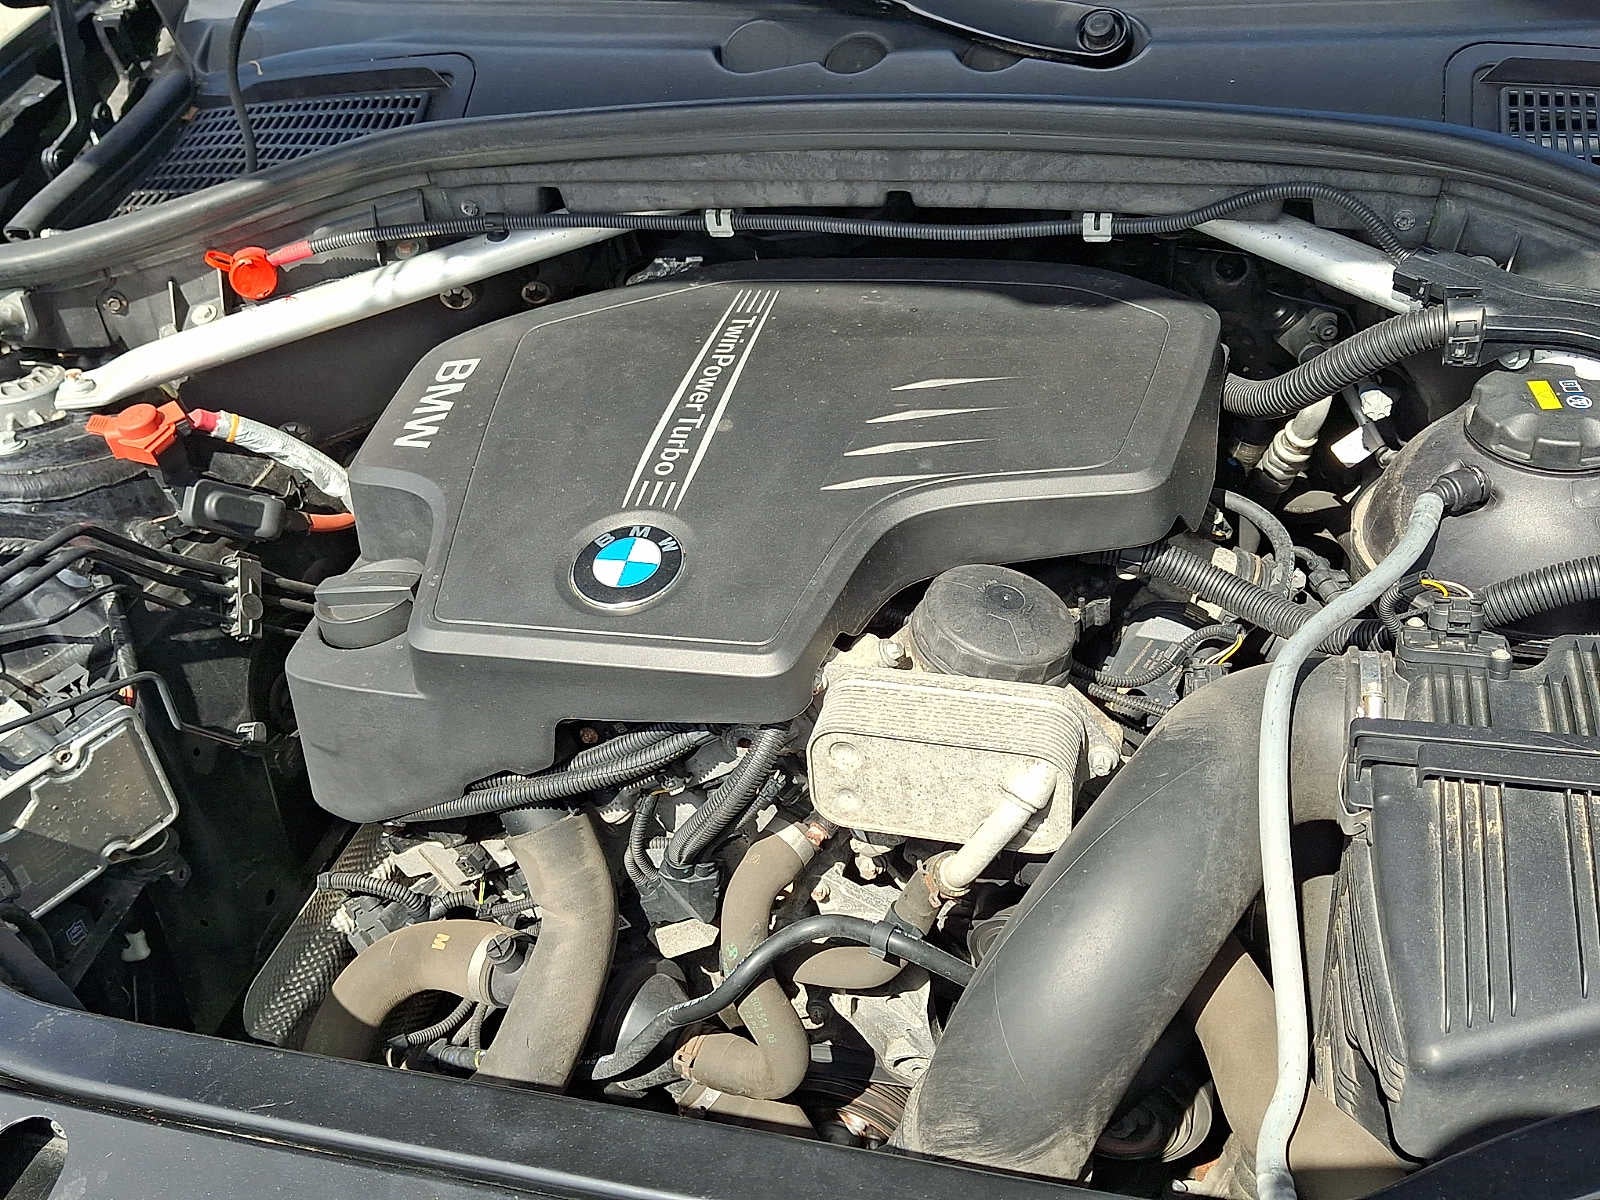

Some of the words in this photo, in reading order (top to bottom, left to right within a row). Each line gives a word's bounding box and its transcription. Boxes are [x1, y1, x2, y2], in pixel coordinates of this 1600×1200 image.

[686, 316, 757, 411] TwinPower
[393, 358, 481, 448] BMW
[654, 413, 705, 476] Turbo
[594, 526, 679, 552] BMW
